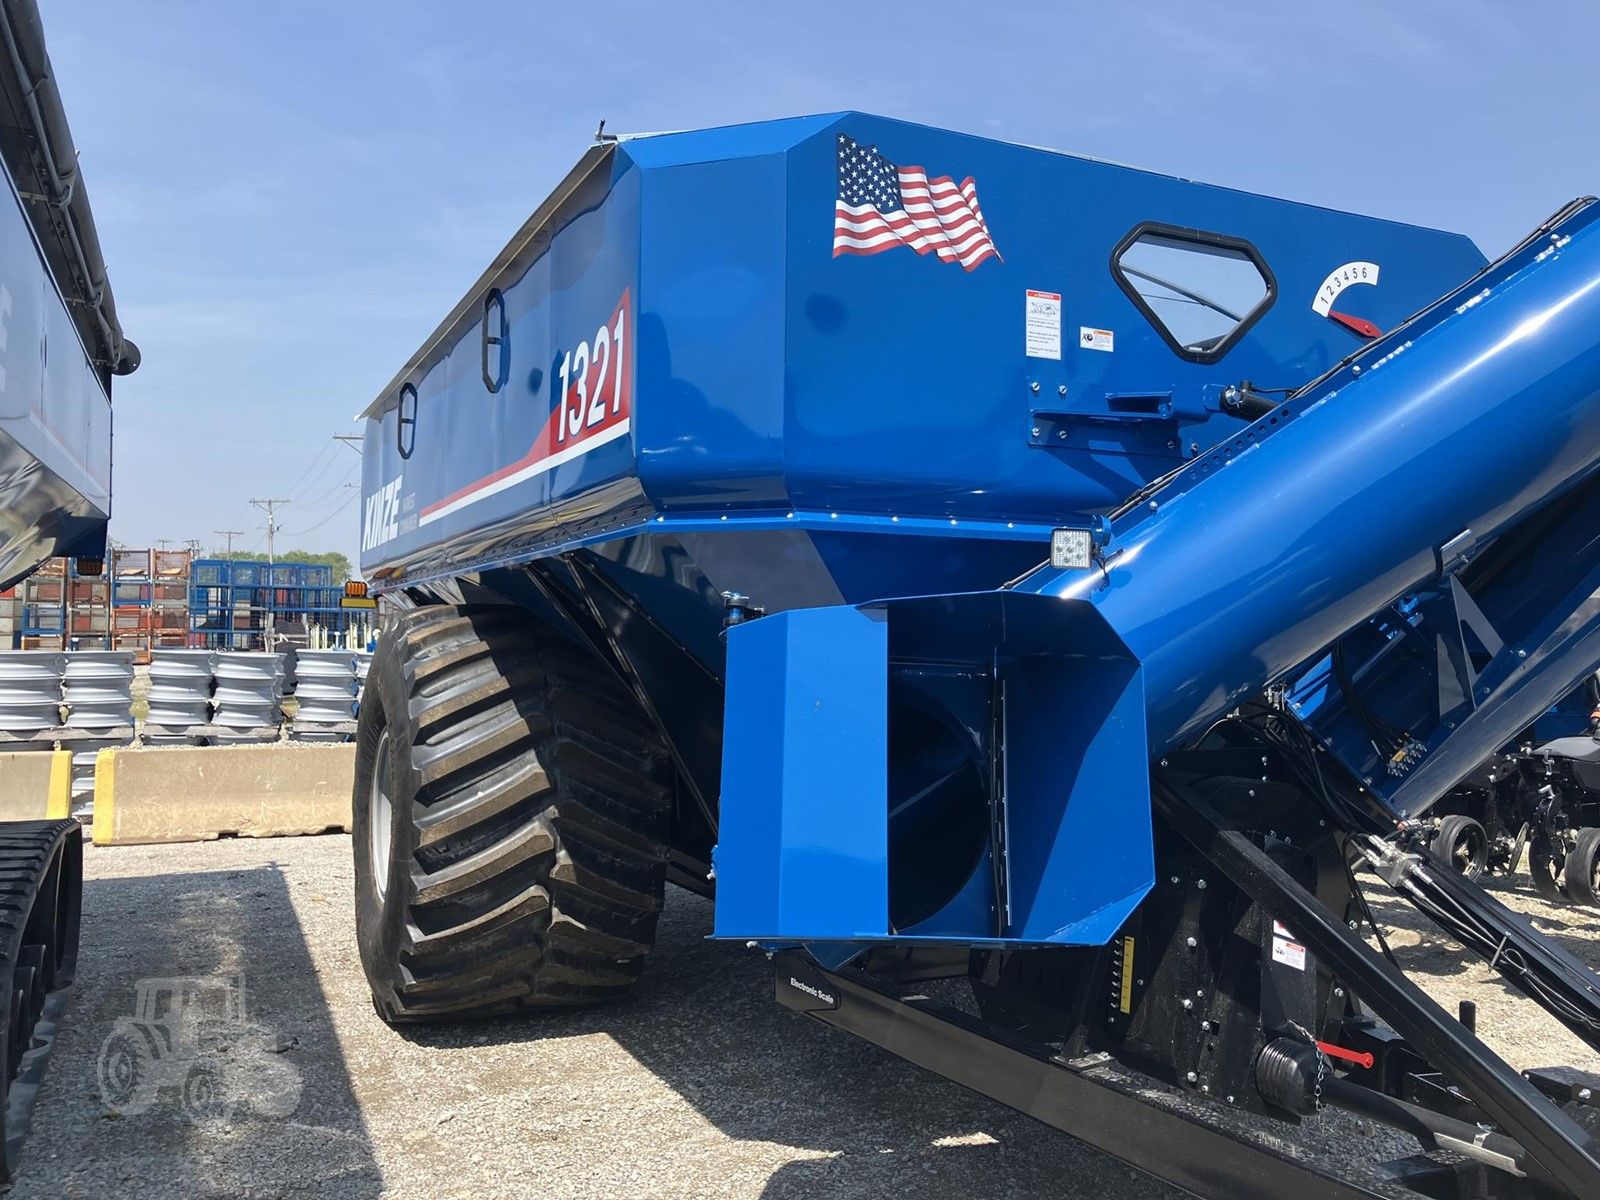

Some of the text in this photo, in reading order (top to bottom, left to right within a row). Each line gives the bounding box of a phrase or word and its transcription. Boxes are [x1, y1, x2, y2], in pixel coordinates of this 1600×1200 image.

[1320, 267, 1367, 305] 1 2 3 4 5 6
[558, 309, 626, 442] 1321
[362, 474, 403, 553] KINZE
[790, 977, 817, 997] Electronic
